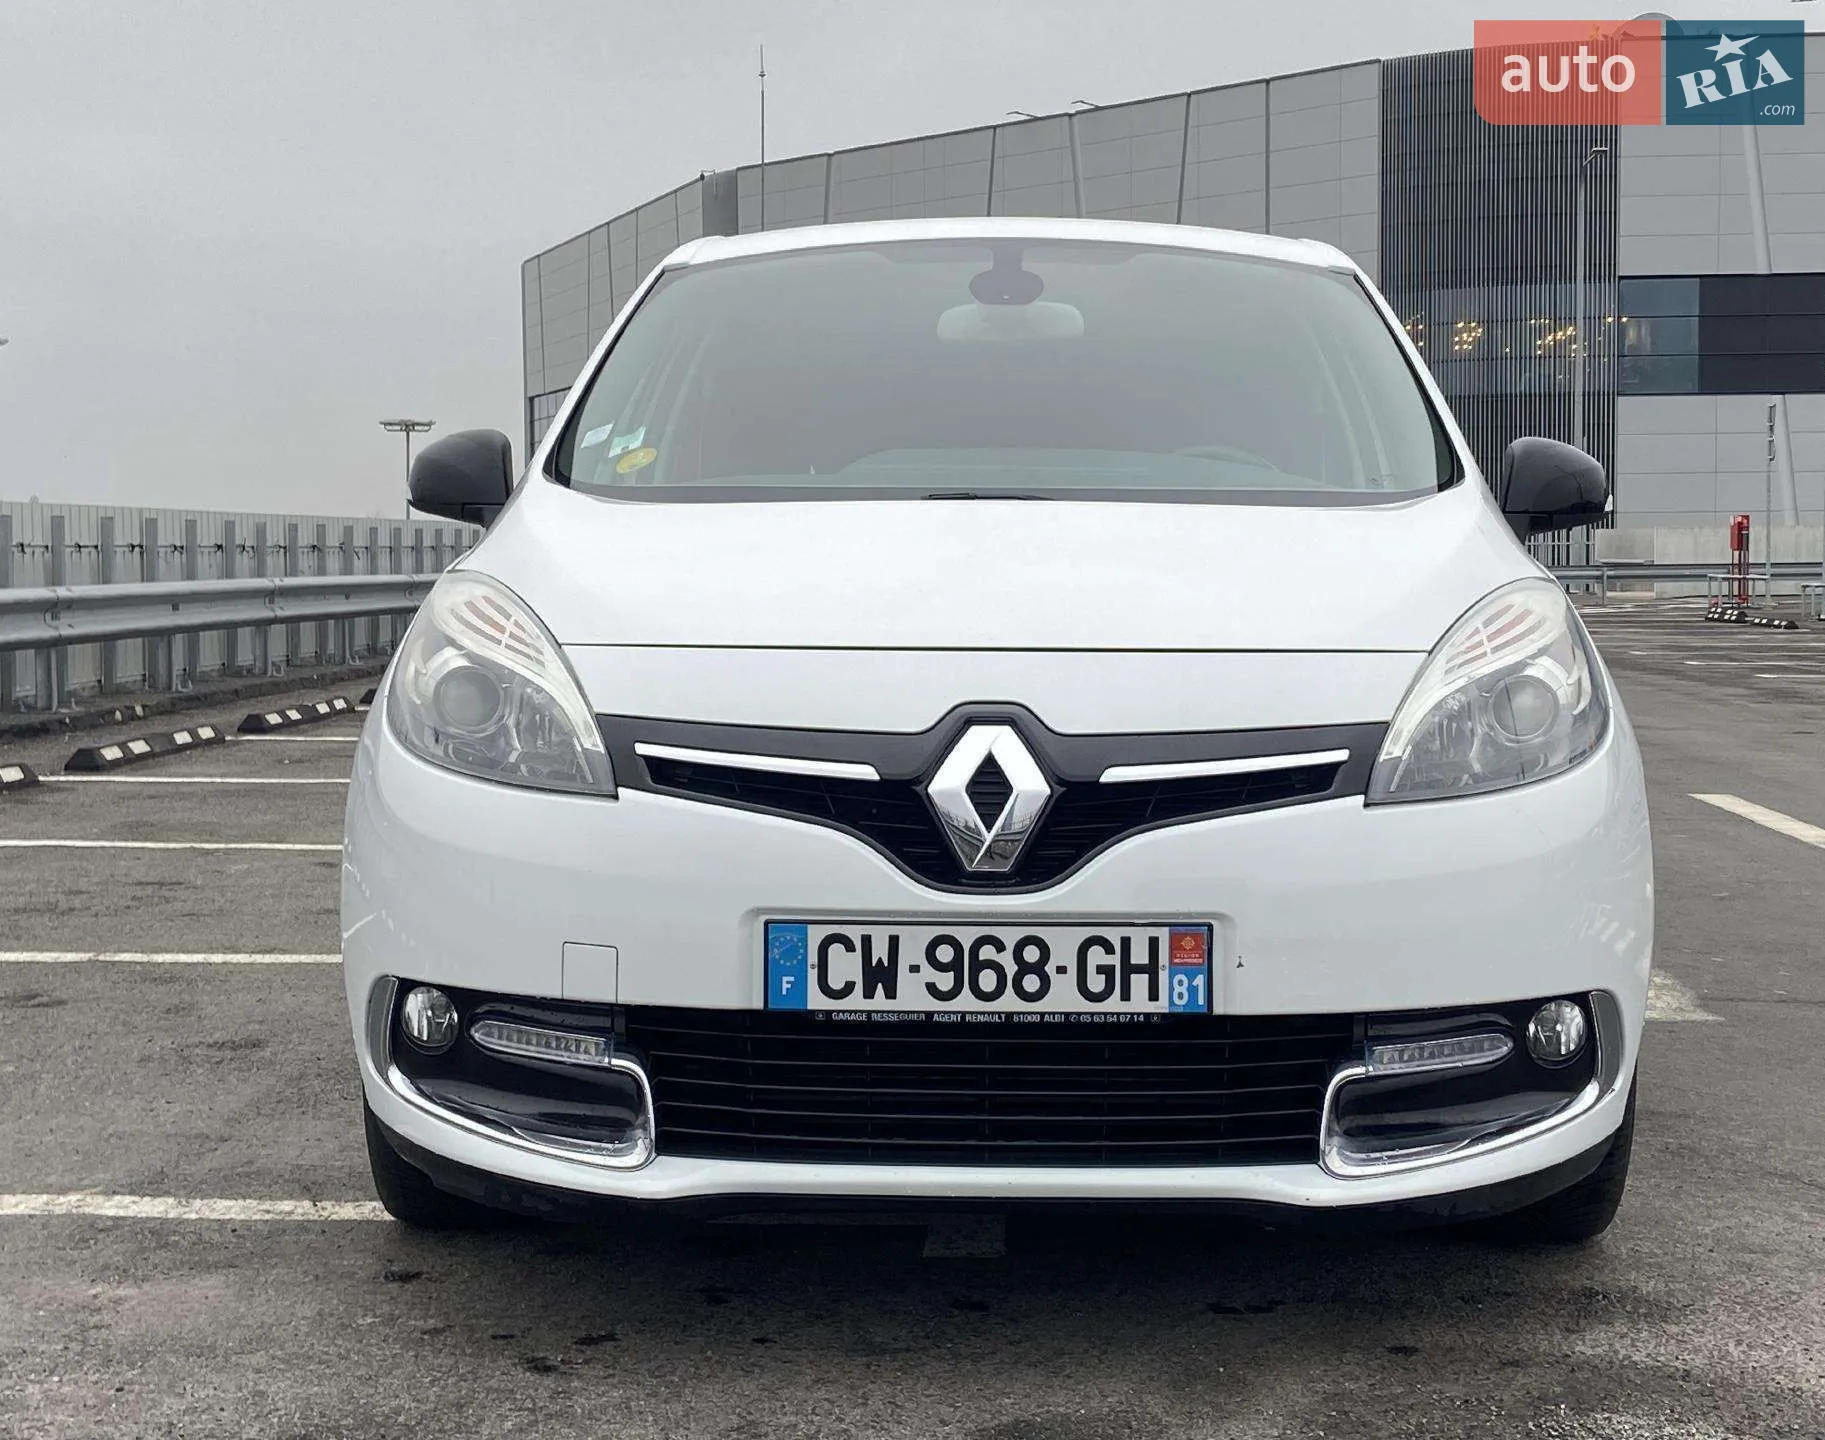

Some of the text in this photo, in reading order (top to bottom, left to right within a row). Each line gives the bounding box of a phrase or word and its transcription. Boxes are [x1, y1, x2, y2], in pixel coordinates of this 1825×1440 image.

[816, 933, 1160, 1002] CW-968-GH
[782, 976, 794, 995] F
[1172, 974, 1204, 1005] 81
[831, 1012, 868, 1021] GARAGE
[932, 1013, 962, 1022] AGENT
[965, 1013, 1006, 1022] RENAULT
